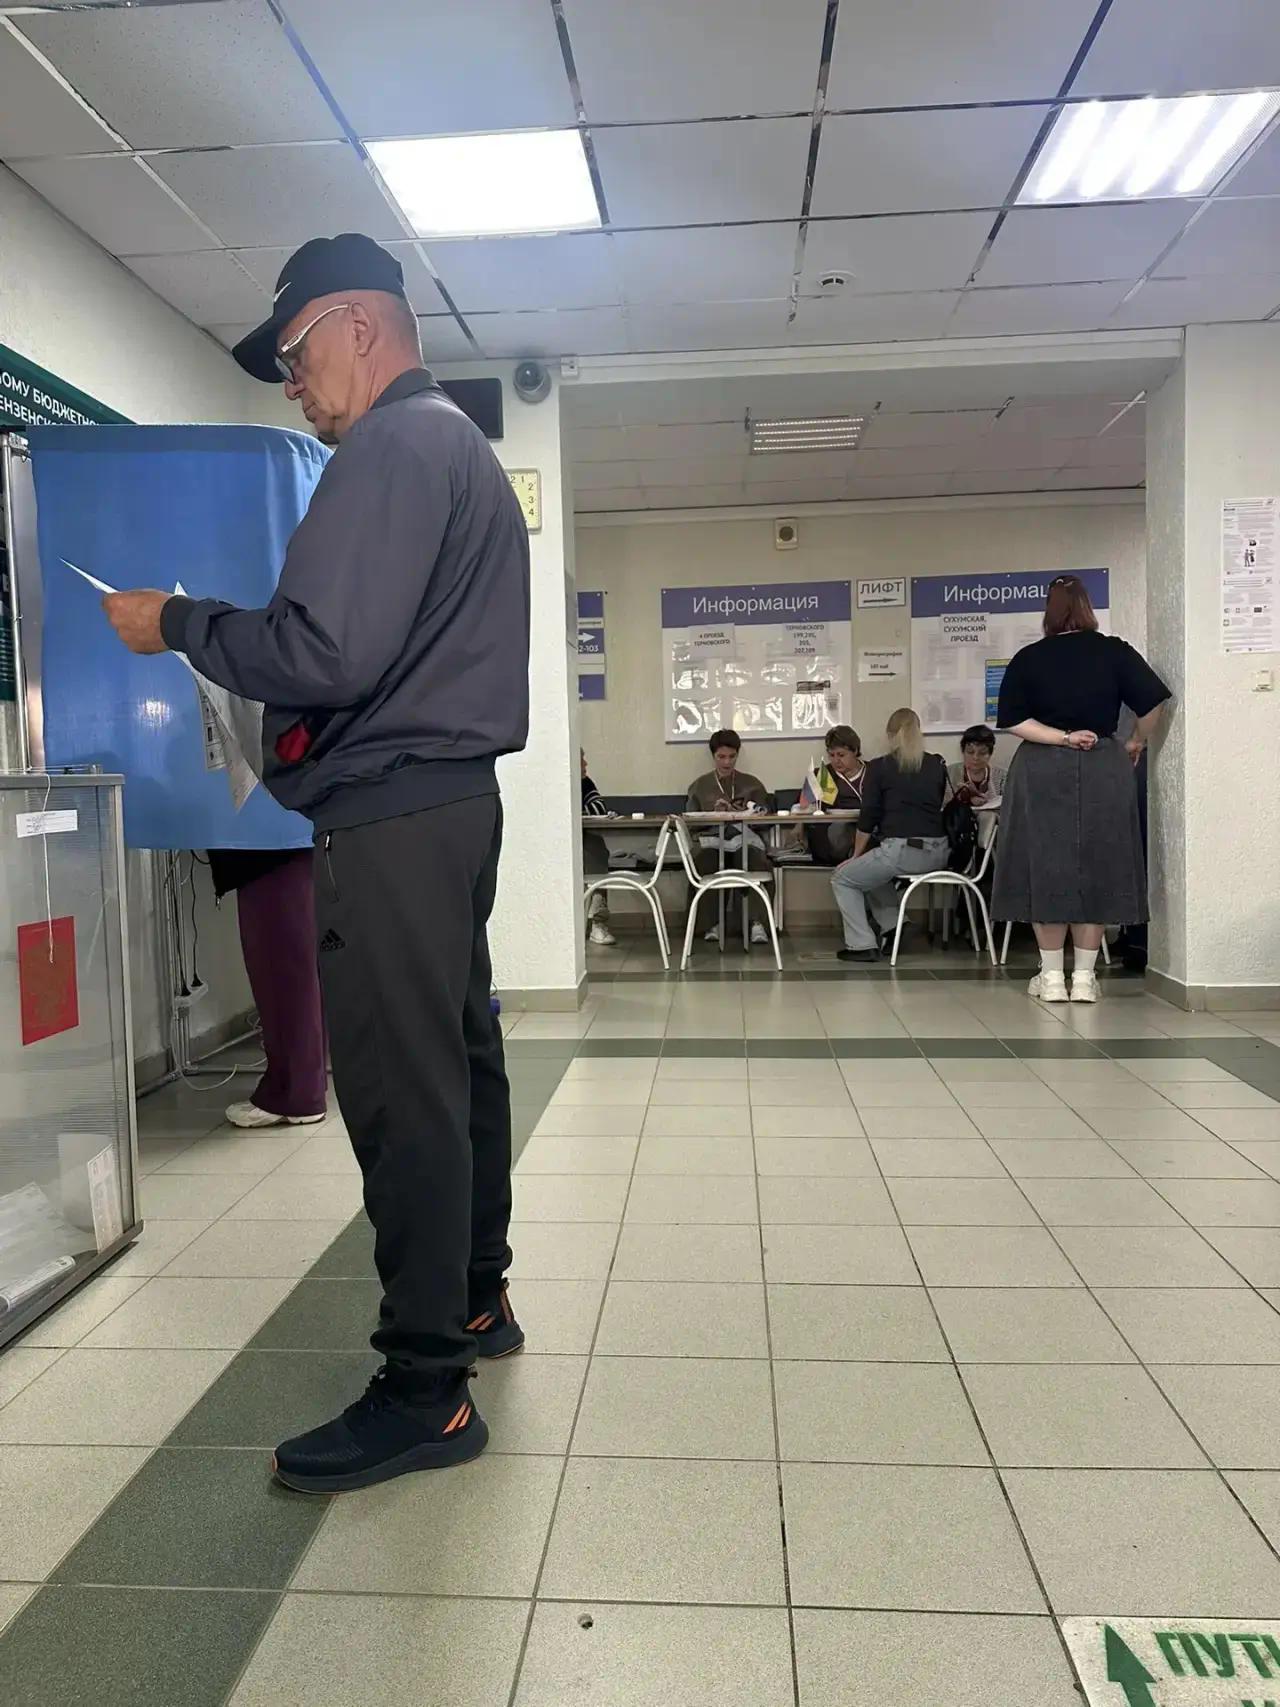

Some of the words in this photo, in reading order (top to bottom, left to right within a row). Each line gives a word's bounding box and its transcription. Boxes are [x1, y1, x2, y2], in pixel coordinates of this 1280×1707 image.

[0, 372, 30, 397] ОМУ
[33, 388, 99, 425] БЮДЖЕТН
[528, 482, 534, 491] 2
[528, 496, 534, 504] 3
[528, 508, 534, 516] 4
[860, 582, 902, 594] ЛИФТ
[693, 596, 818, 616] Информация
[943, 624, 986, 632] СУХУМСКИЙ
